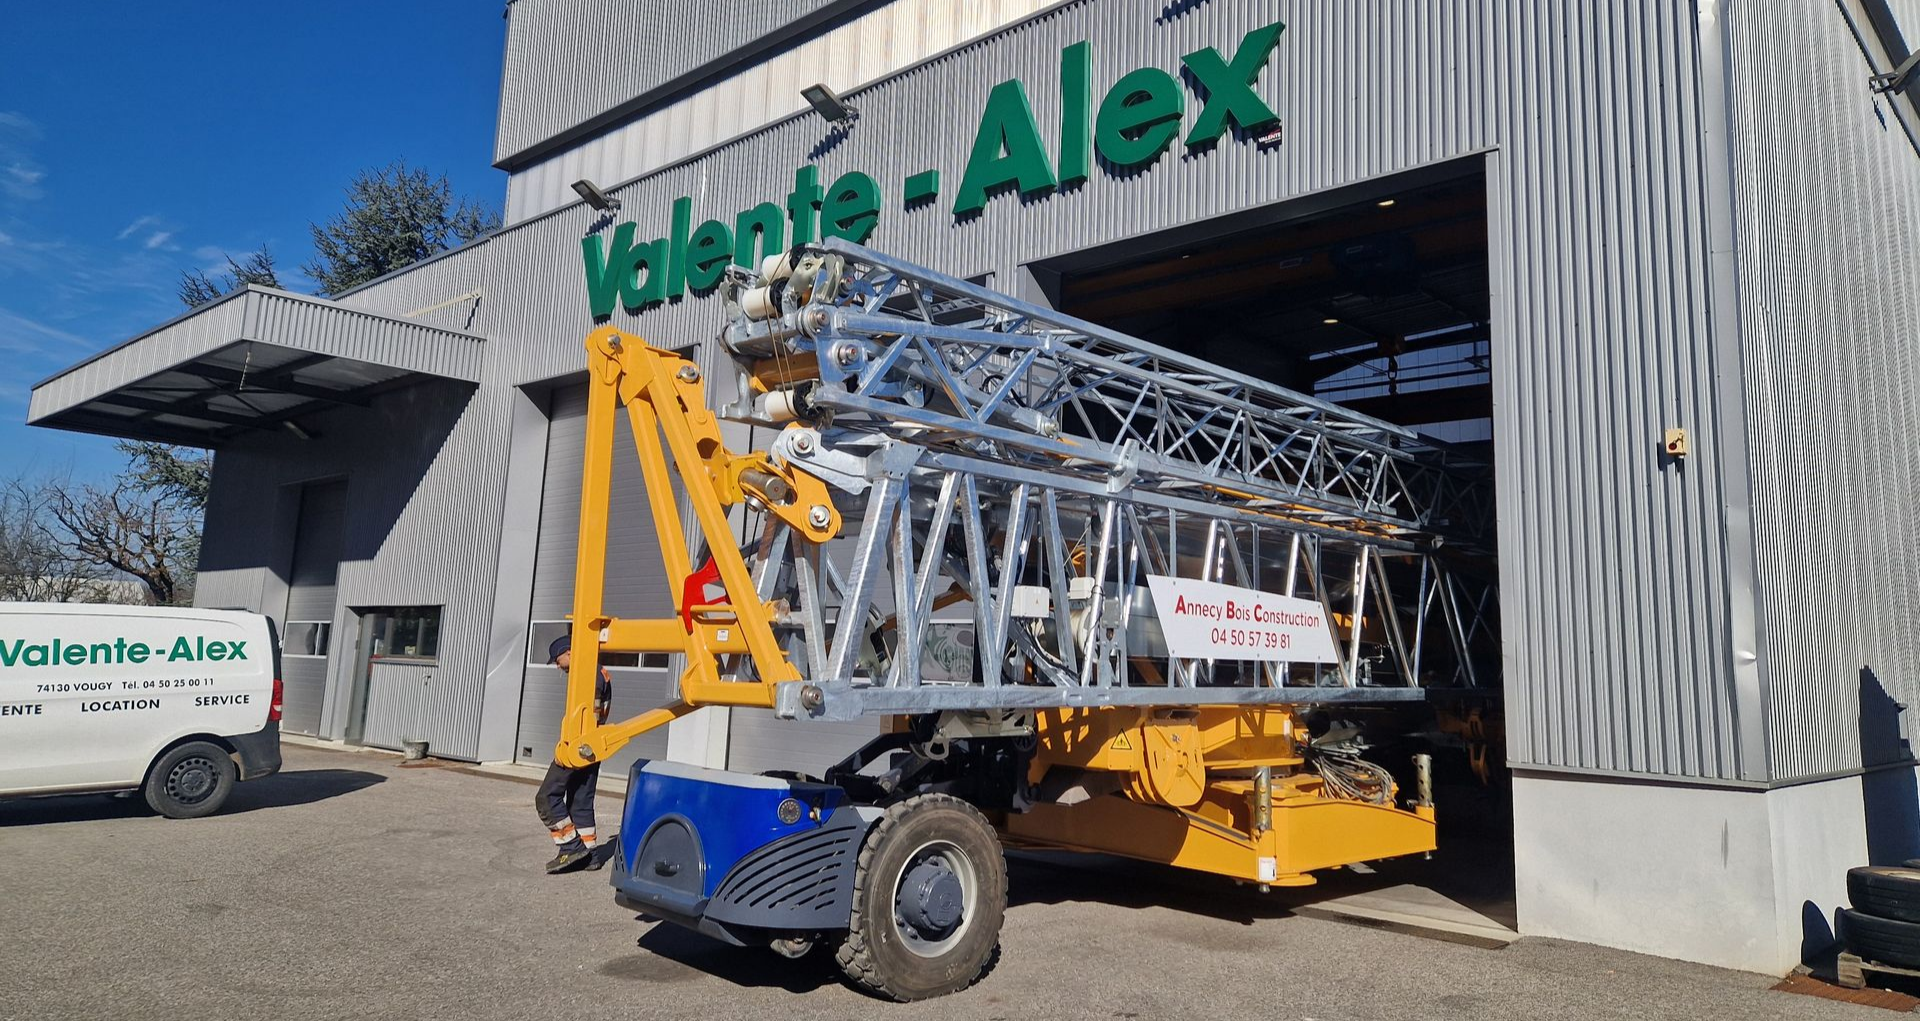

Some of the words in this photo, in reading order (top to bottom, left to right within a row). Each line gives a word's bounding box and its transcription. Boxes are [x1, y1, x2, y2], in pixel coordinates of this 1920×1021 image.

[581, 164, 881, 318] Valente
[952, 21, 1286, 216] Alex
[1174, 595, 1223, 621] Annecy
[1226, 601, 1251, 621] Bois
[1254, 604, 1320, 628] Construction
[1211, 628, 1227, 644] 04
[1231, 629, 1245, 646] 50
[1249, 631, 1261, 647] 57
[1265, 633, 1277, 648] 39
[1280, 634, 1291, 649] 81
[37, 683, 70, 693] 74130
[73, 681, 112, 692] VOUGY
[122, 681, 140, 690] Tél.
[143, 680, 155, 689] 04
[159, 679, 171, 688] 50
[174, 679, 186, 688] 25
[188, 678, 200, 687] 00
[204, 677, 215, 686] 11
[0, 704, 42, 716] ENTE
[81, 698, 160, 712] LOCATION
[195, 694, 250, 707] SERVICE
